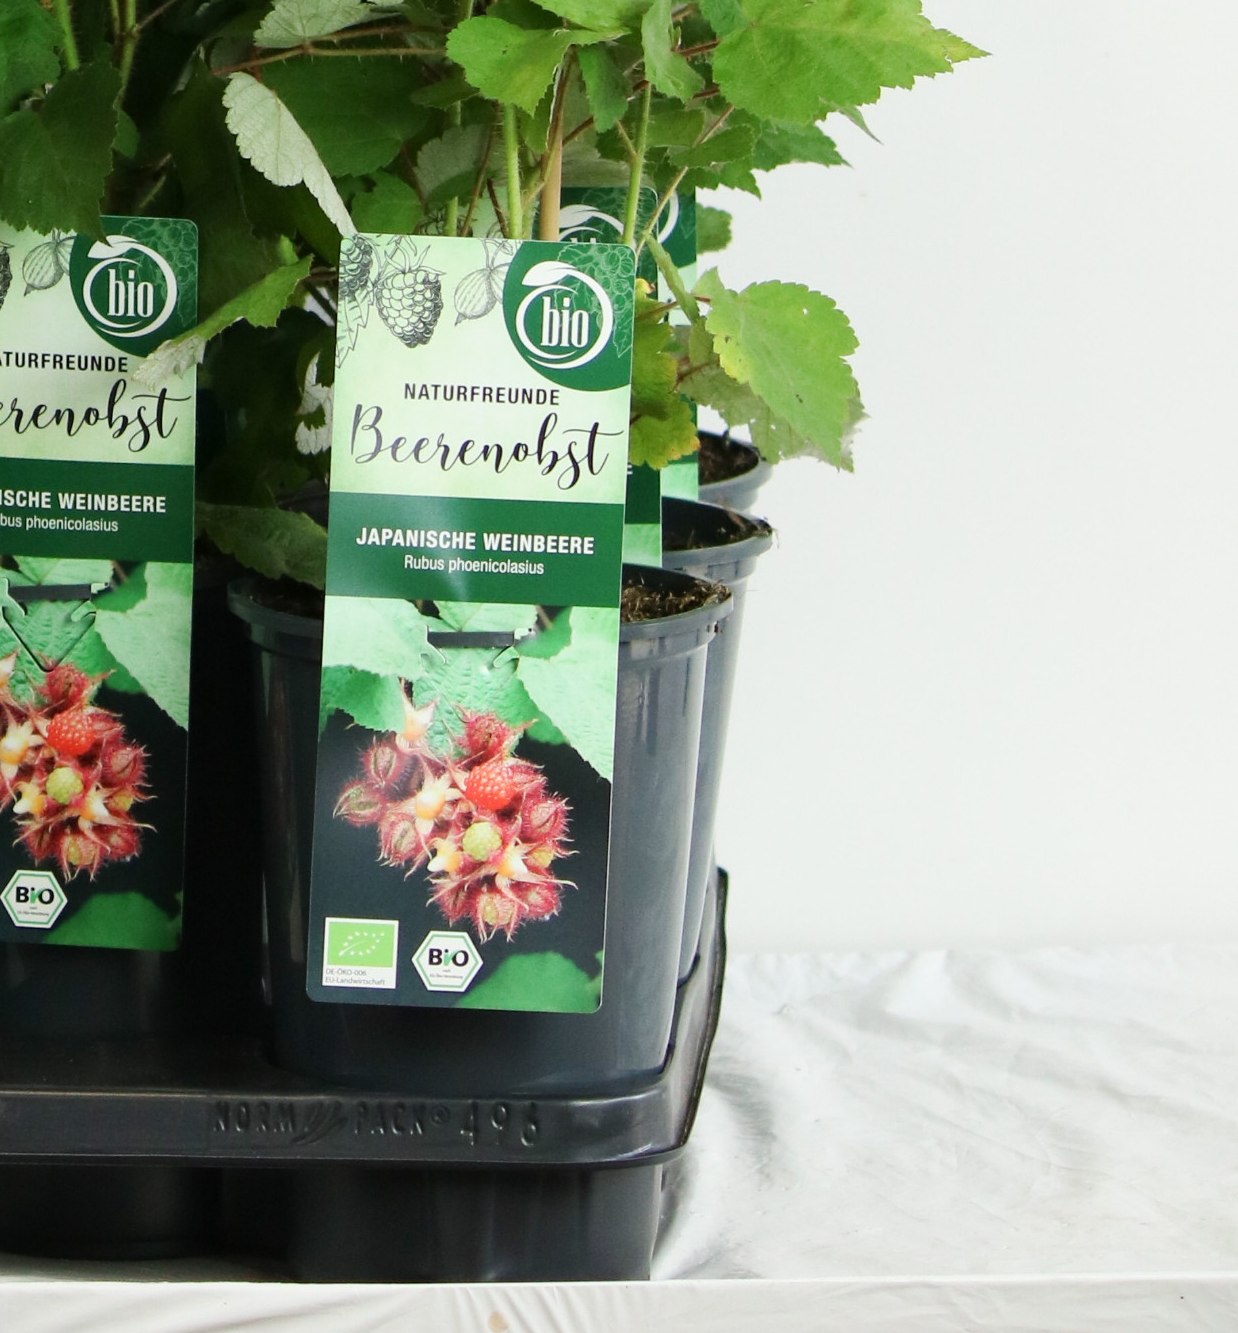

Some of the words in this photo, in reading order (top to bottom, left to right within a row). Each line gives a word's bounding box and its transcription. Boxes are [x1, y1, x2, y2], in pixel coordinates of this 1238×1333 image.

[107, 268, 154, 318] bio
[540, 296, 589, 348] bio
[404, 383, 560, 406] NATURFREUNDE
[351, 404, 624, 490] Beerenobst
[57, 492, 166, 513] WEINBEERE
[25, 515, 119, 532] phoenicolasius
[355, 527, 476, 550] JAPANISCHE
[483, 532, 595, 555] WEINBEERE
[404, 554, 446, 571] Rubus
[447, 556, 545, 575] phoenicolasius
